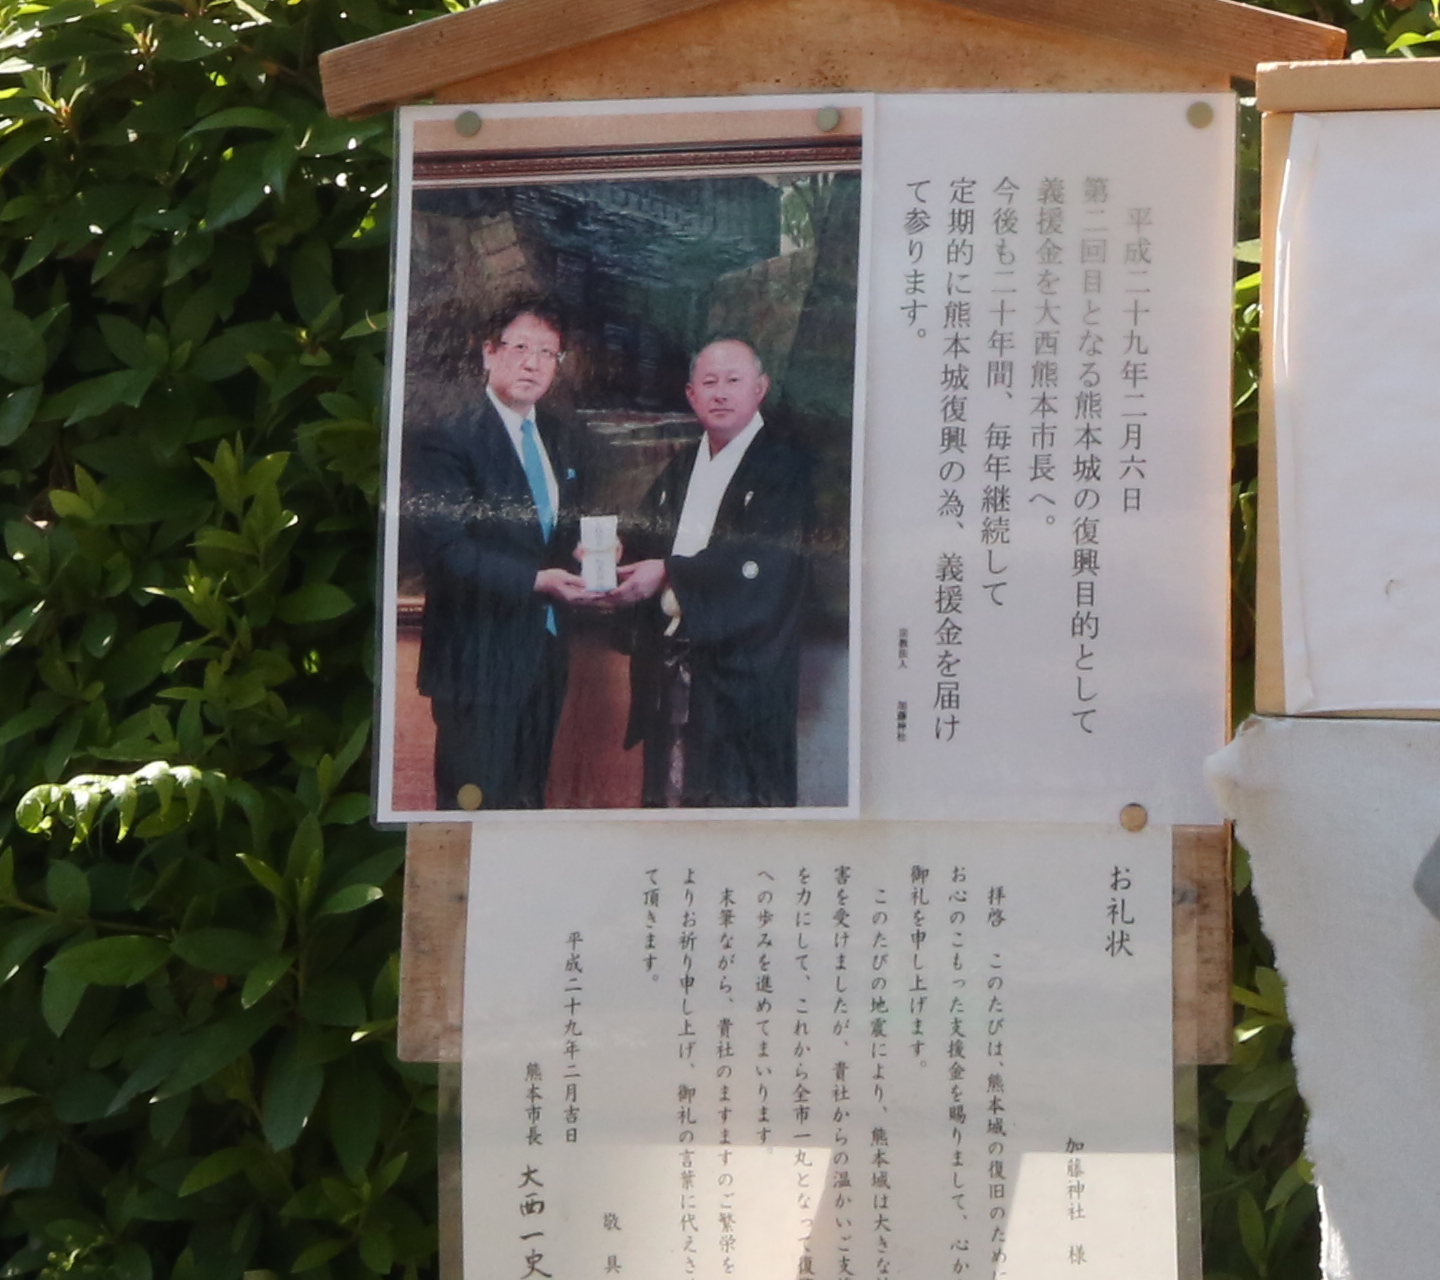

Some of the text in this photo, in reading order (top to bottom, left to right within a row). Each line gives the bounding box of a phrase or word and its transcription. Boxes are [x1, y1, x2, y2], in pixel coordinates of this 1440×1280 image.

[900, 179, 931, 339] て参ります。
[1028, 176, 1065, 526] 義援金を大西熊本市長へ。
[1119, 207, 1152, 513] 平成二十九年二月六日
[1071, 176, 1109, 734] 第二回目となる熊本城の復興目的として
[643, 868, 660, 982] て頂きます。
[909, 865, 930, 1067] 御礼を申し上げます。
[988, 886, 1006, 928] 拝啓
[1105, 865, 1135, 957] お礼状
[563, 930, 584, 1144] 平成二十九年二月吉日
[793, 866, 815, 1280] を力にして、これから全市一丸となって復
[832, 865, 854, 1280] 害を受けましたが、貴社からの温かいご支
[870, 889, 891, 1280] このたびの地震により、熊本城は大きな
[518, 1062, 553, 1279] 熊本市長 大西一史
[1065, 1137, 1088, 1266] 加藤神社 様
